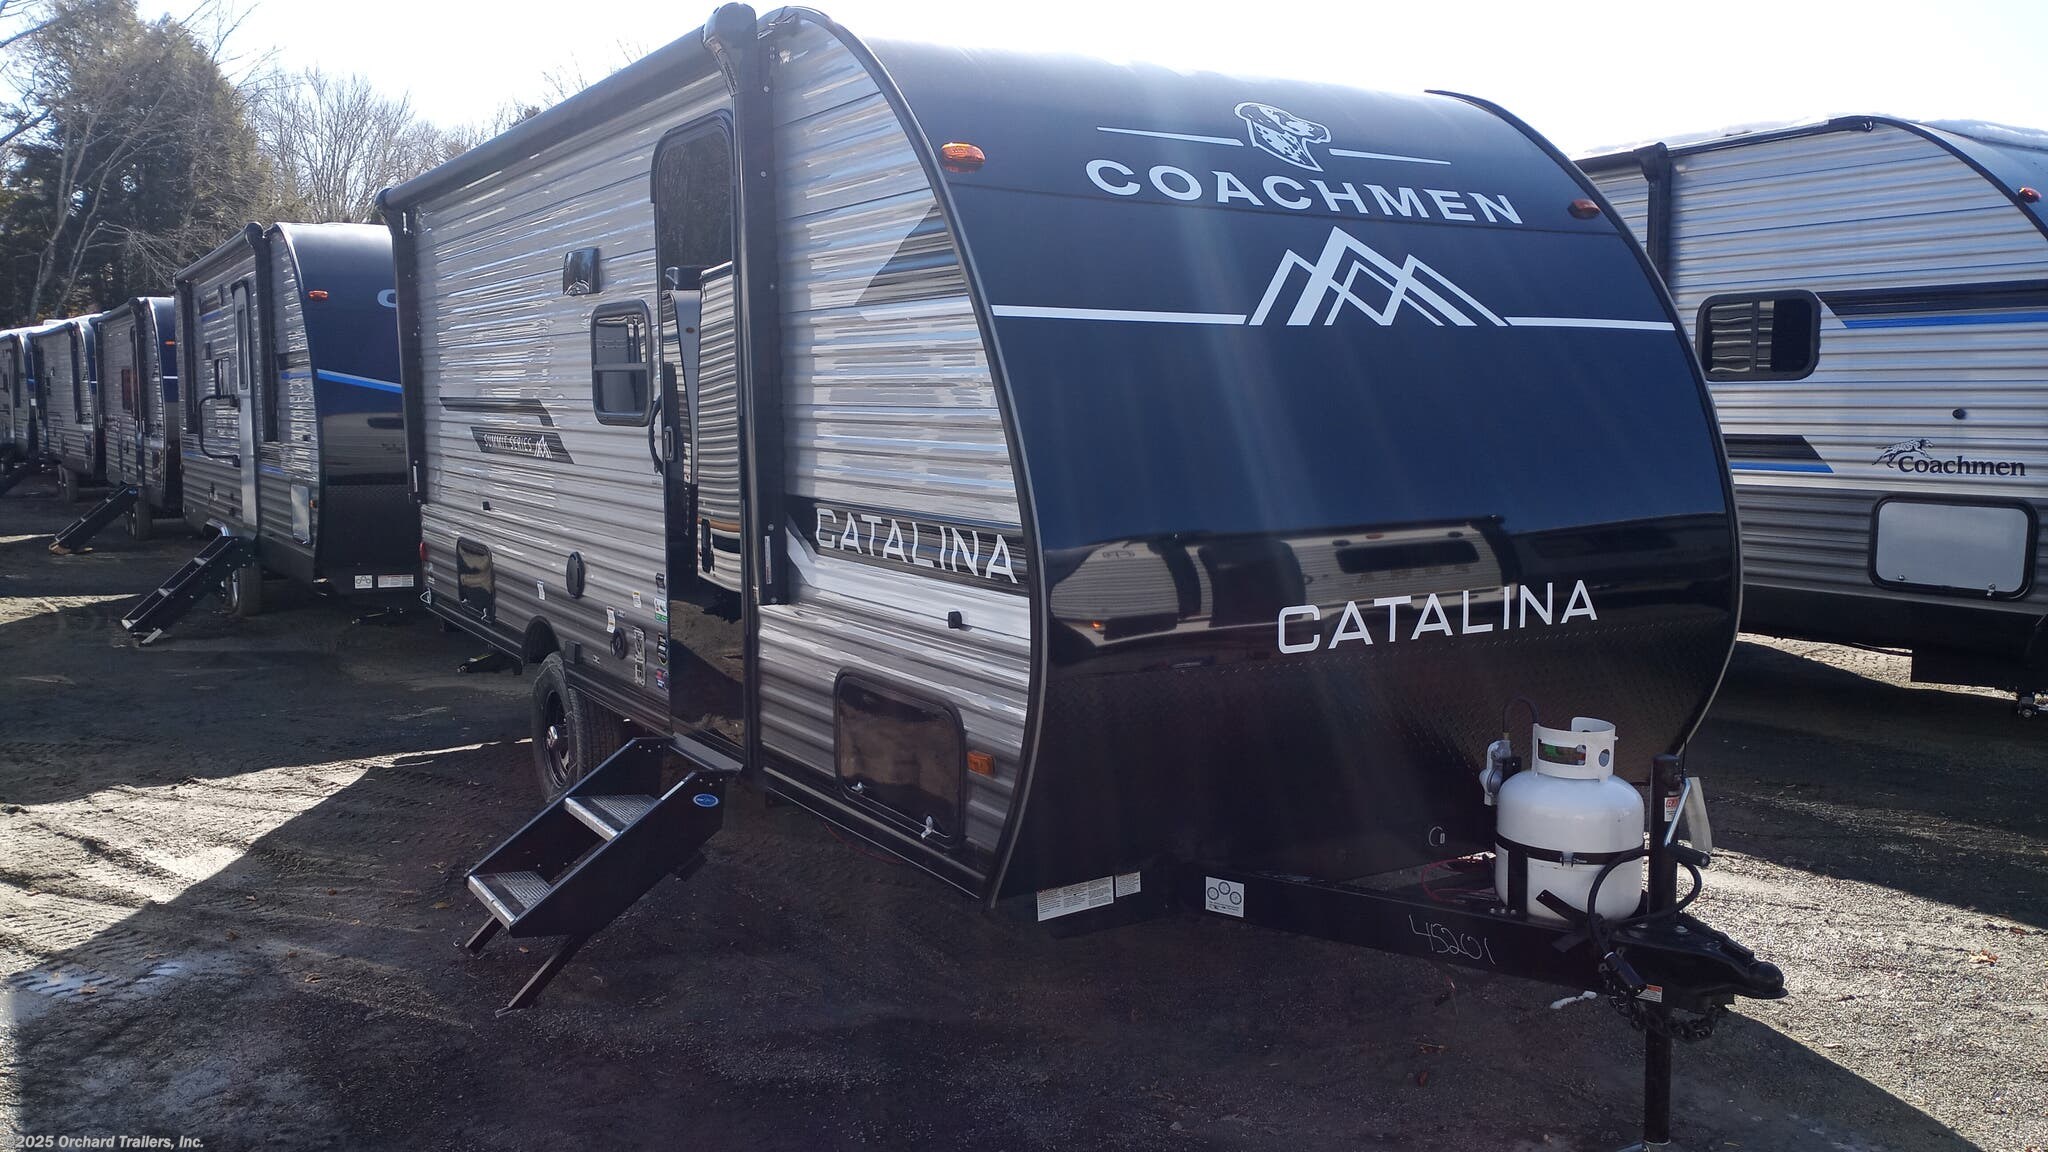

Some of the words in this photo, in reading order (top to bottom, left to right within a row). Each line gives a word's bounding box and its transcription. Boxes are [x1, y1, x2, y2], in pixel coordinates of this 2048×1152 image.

[1085, 159, 1523, 224] COACHMEN
[1897, 455, 2026, 476] Coachmen
[816, 508, 1018, 584] CATALINA
[1278, 579, 1598, 654] CATALINA
